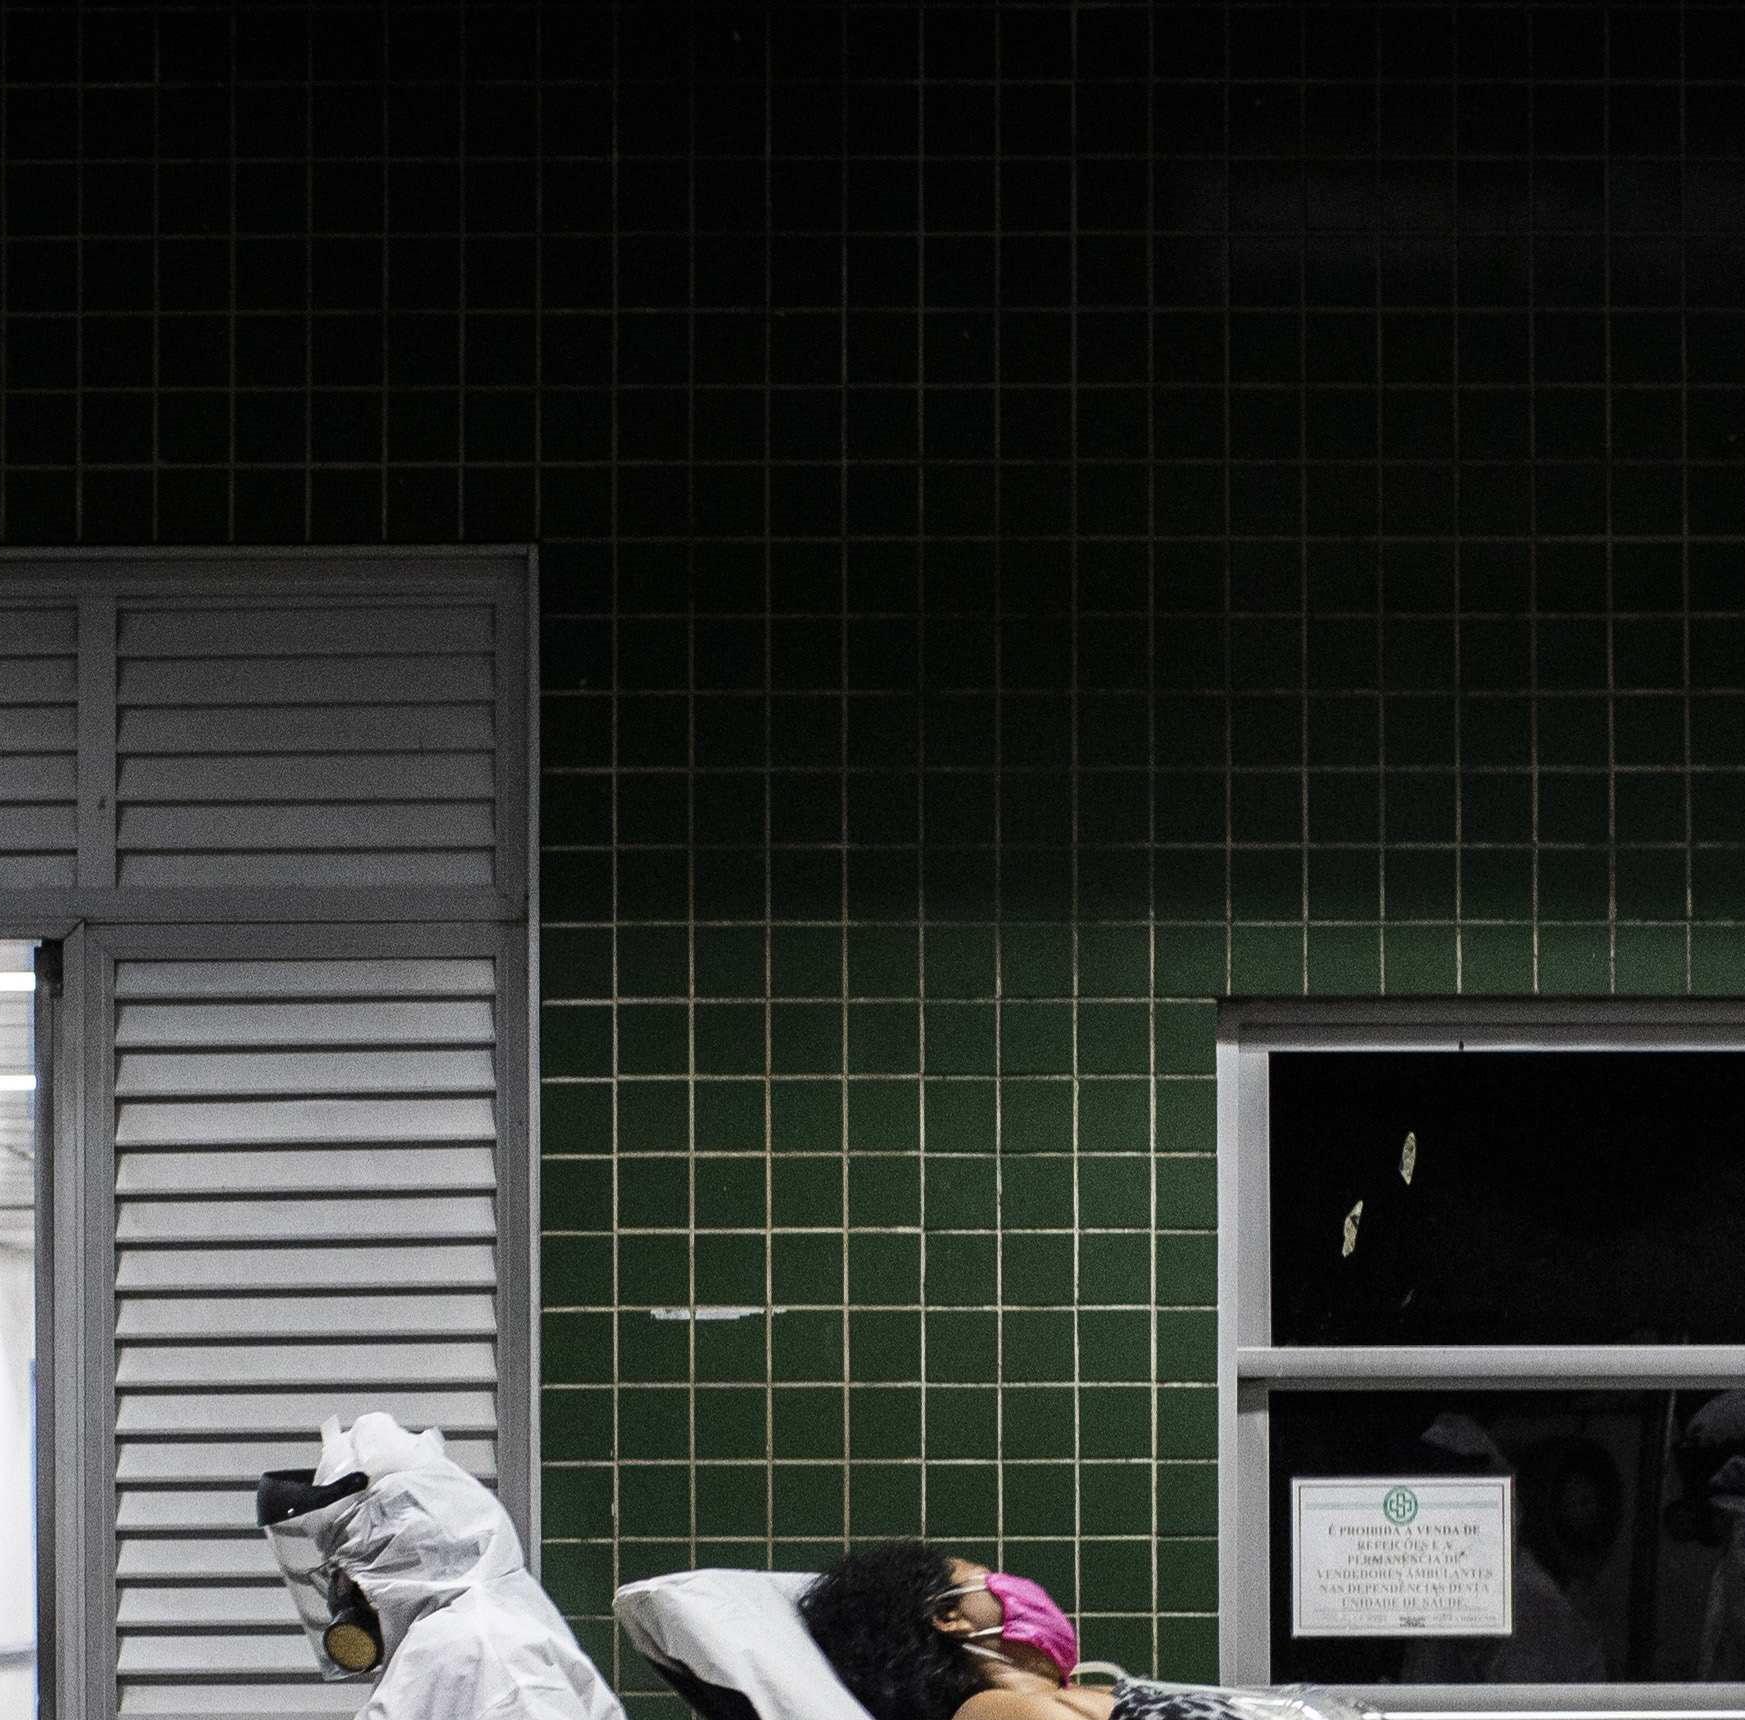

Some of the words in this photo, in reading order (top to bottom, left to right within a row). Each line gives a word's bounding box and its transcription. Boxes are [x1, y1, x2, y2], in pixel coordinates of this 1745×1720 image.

[1328, 1524, 1337, 1536] É
[1339, 1526, 1400, 1536] PROIBIDA
[1416, 1526, 1459, 1536] VENDA
[1464, 1526, 1480, 1536] DE
[1316, 1569, 1402, 1580] VENDEDORES
[1406, 1569, 1493, 1579] AMBULANTES
[1319, 1582, 1343, 1593] NAS
[1448, 1582, 1489, 1594] DESTA
[1342, 1598, 1397, 1608] UNIDADE
[1403, 1598, 1417, 1608] DE
